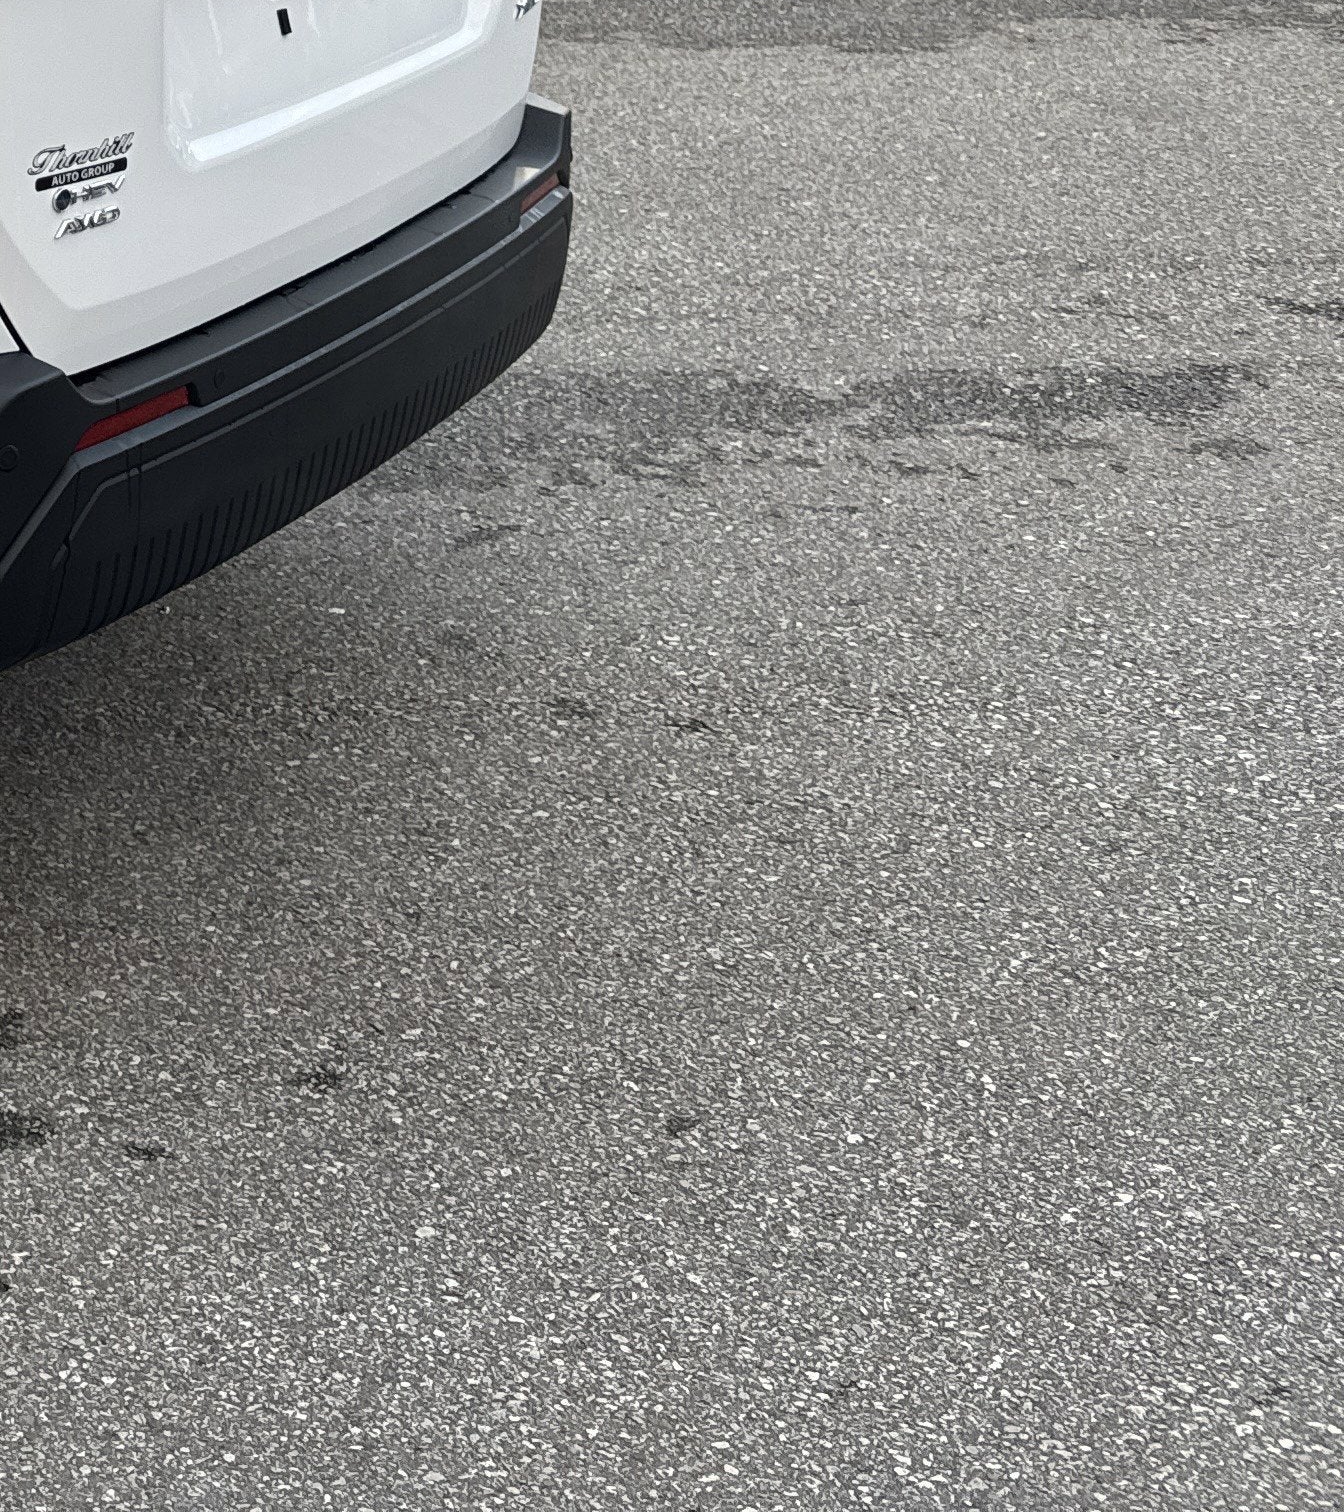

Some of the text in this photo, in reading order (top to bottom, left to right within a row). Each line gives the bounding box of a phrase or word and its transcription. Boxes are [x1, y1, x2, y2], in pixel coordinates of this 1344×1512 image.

[27, 131, 135, 176] Thornhill
[51, 162, 115, 187] AUTO GROUP
[53, 205, 121, 239] AWD
